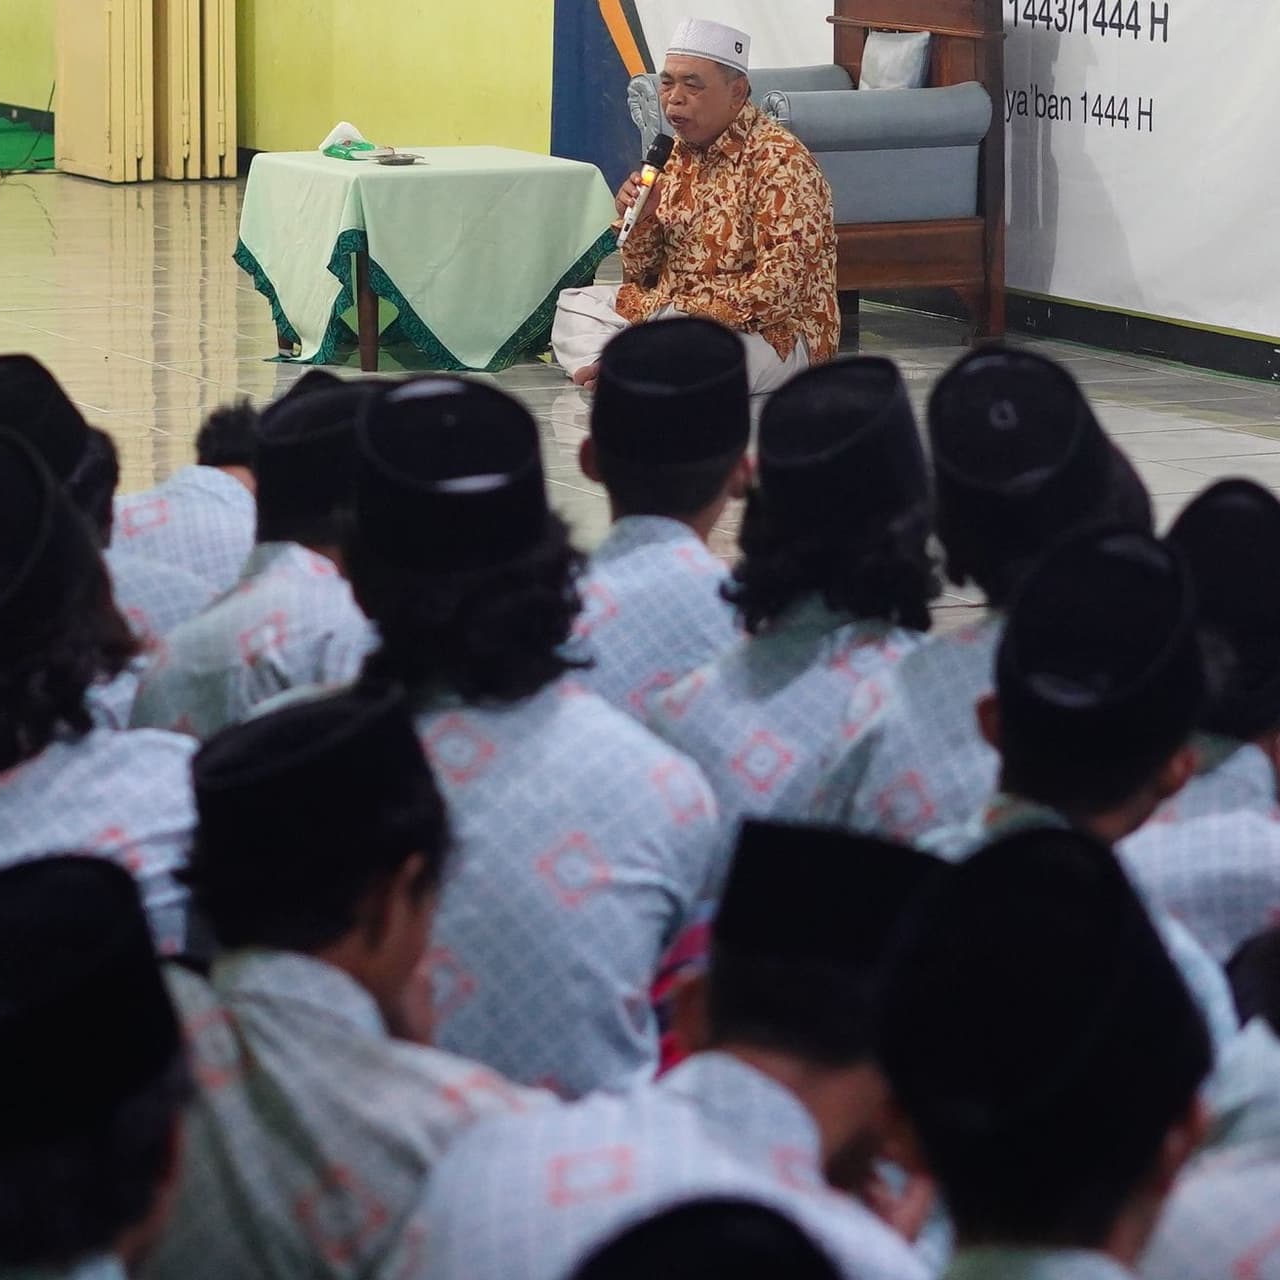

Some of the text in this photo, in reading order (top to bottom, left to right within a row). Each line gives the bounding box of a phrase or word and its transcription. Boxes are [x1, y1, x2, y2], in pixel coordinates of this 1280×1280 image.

[1149, 0, 1170, 43] H
[1004, 83, 1154, 132] ya'ban 1444 H
